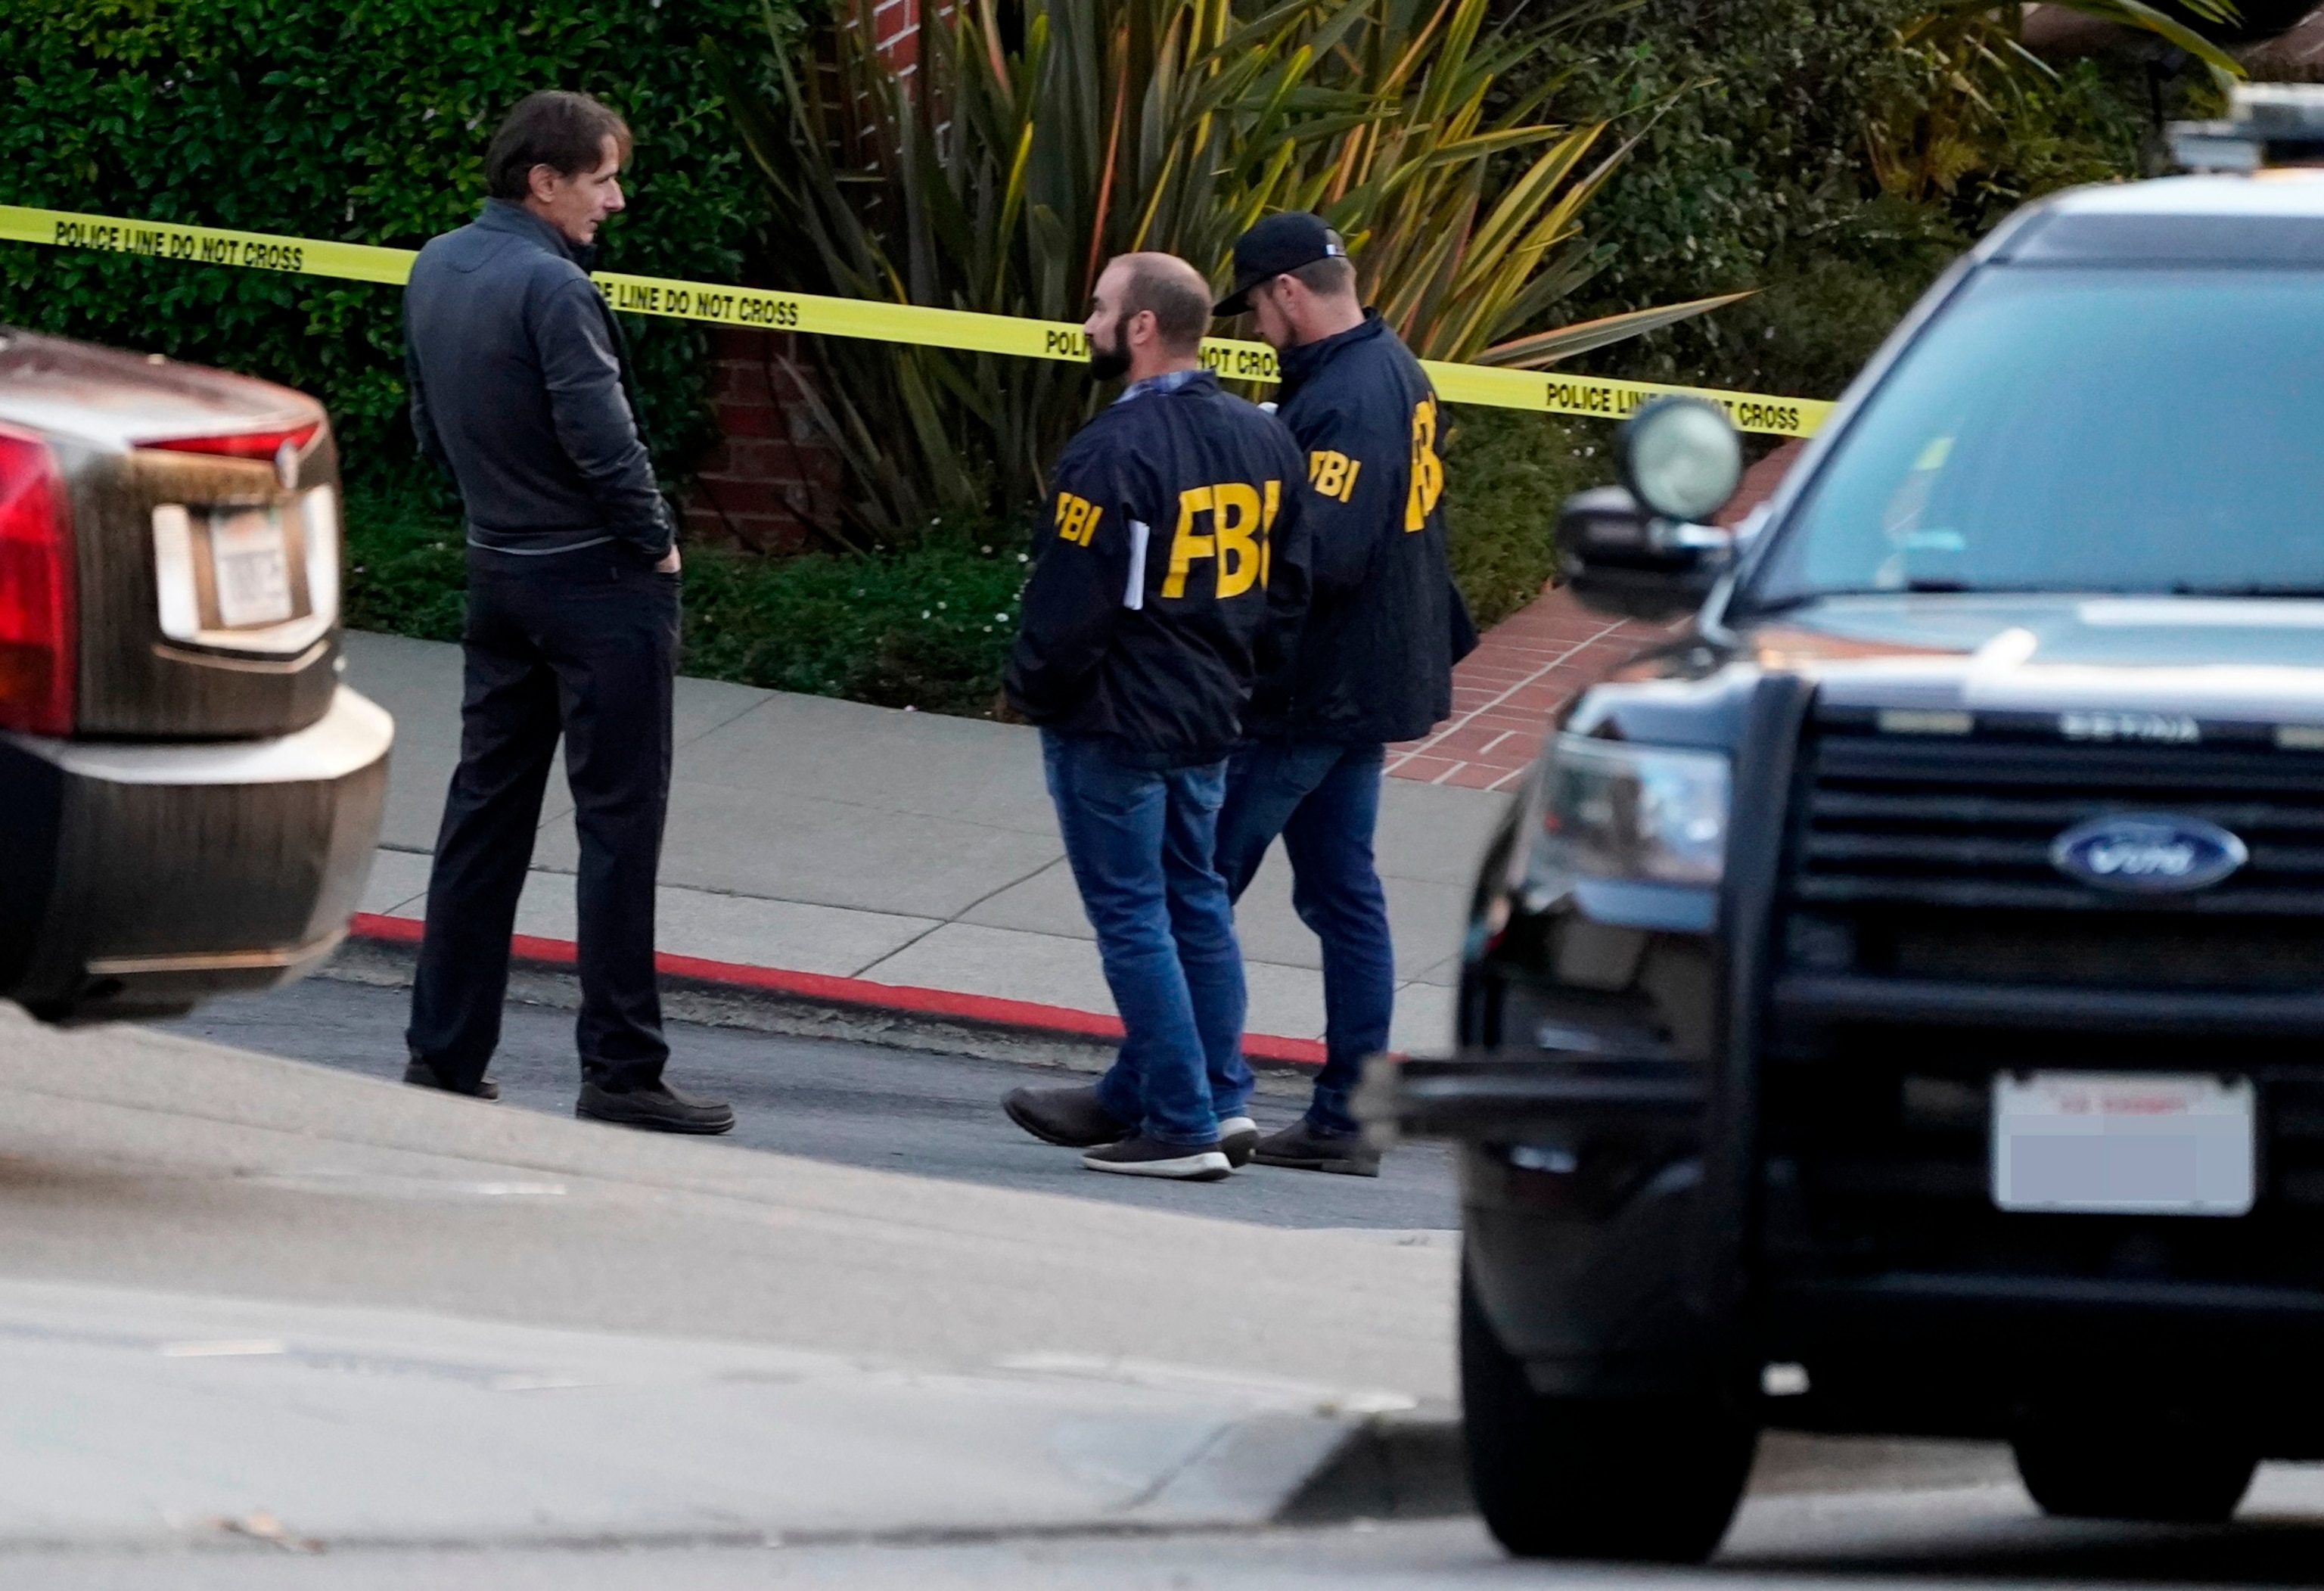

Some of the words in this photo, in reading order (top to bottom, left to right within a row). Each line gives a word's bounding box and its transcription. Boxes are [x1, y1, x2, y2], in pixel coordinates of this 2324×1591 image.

[54, 221, 120, 250] POLICE
[124, 228, 164, 256] LINE
[169, 234, 194, 259] DO
[201, 237, 239, 264] NOT
[244, 241, 302, 271] CROSS
[619, 284, 659, 312] LINE
[666, 289, 690, 314] DO
[696, 292, 735, 319] NOT
[738, 297, 798, 326] CROSS
[1546, 382, 1611, 412] POLICE
[1739, 402, 1800, 430] CROSS
[1309, 449, 1362, 503] FBI
[1054, 491, 1104, 547] FBI
[1160, 480, 1282, 599] FBI
